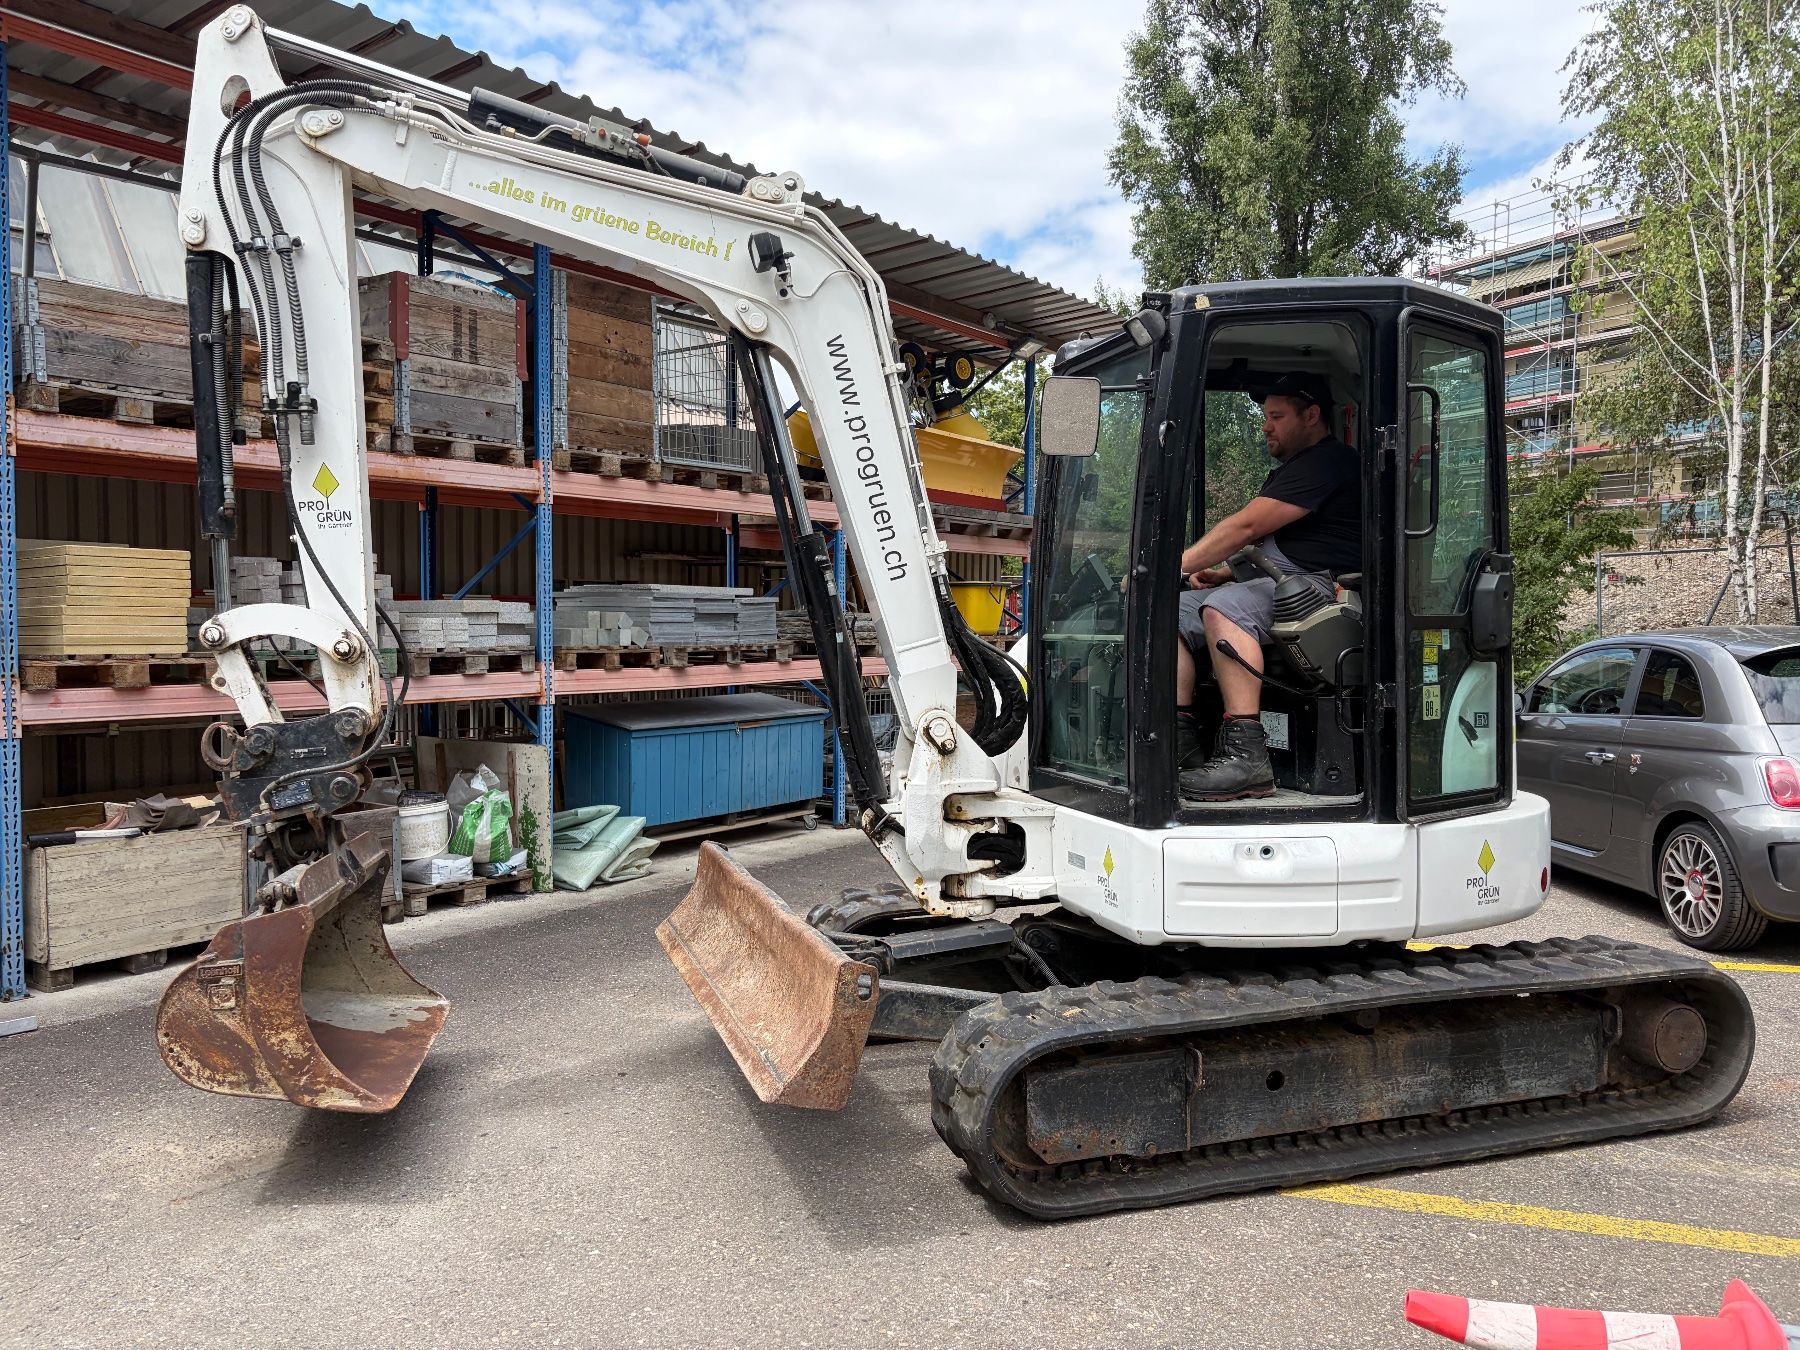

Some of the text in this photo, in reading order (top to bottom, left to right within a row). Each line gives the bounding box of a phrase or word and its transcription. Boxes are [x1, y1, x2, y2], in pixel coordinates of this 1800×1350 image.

[540, 191, 567, 213] im
[571, 203, 640, 235] grüene
[645, 220, 718, 258] Bereich
[826, 334, 907, 582] www.progruen.ch
[298, 500, 325, 511] PRO
[317, 509, 352, 522] GRÜN
[1466, 877, 1485, 889] PRO
[1477, 885, 1500, 899] GRÜN
